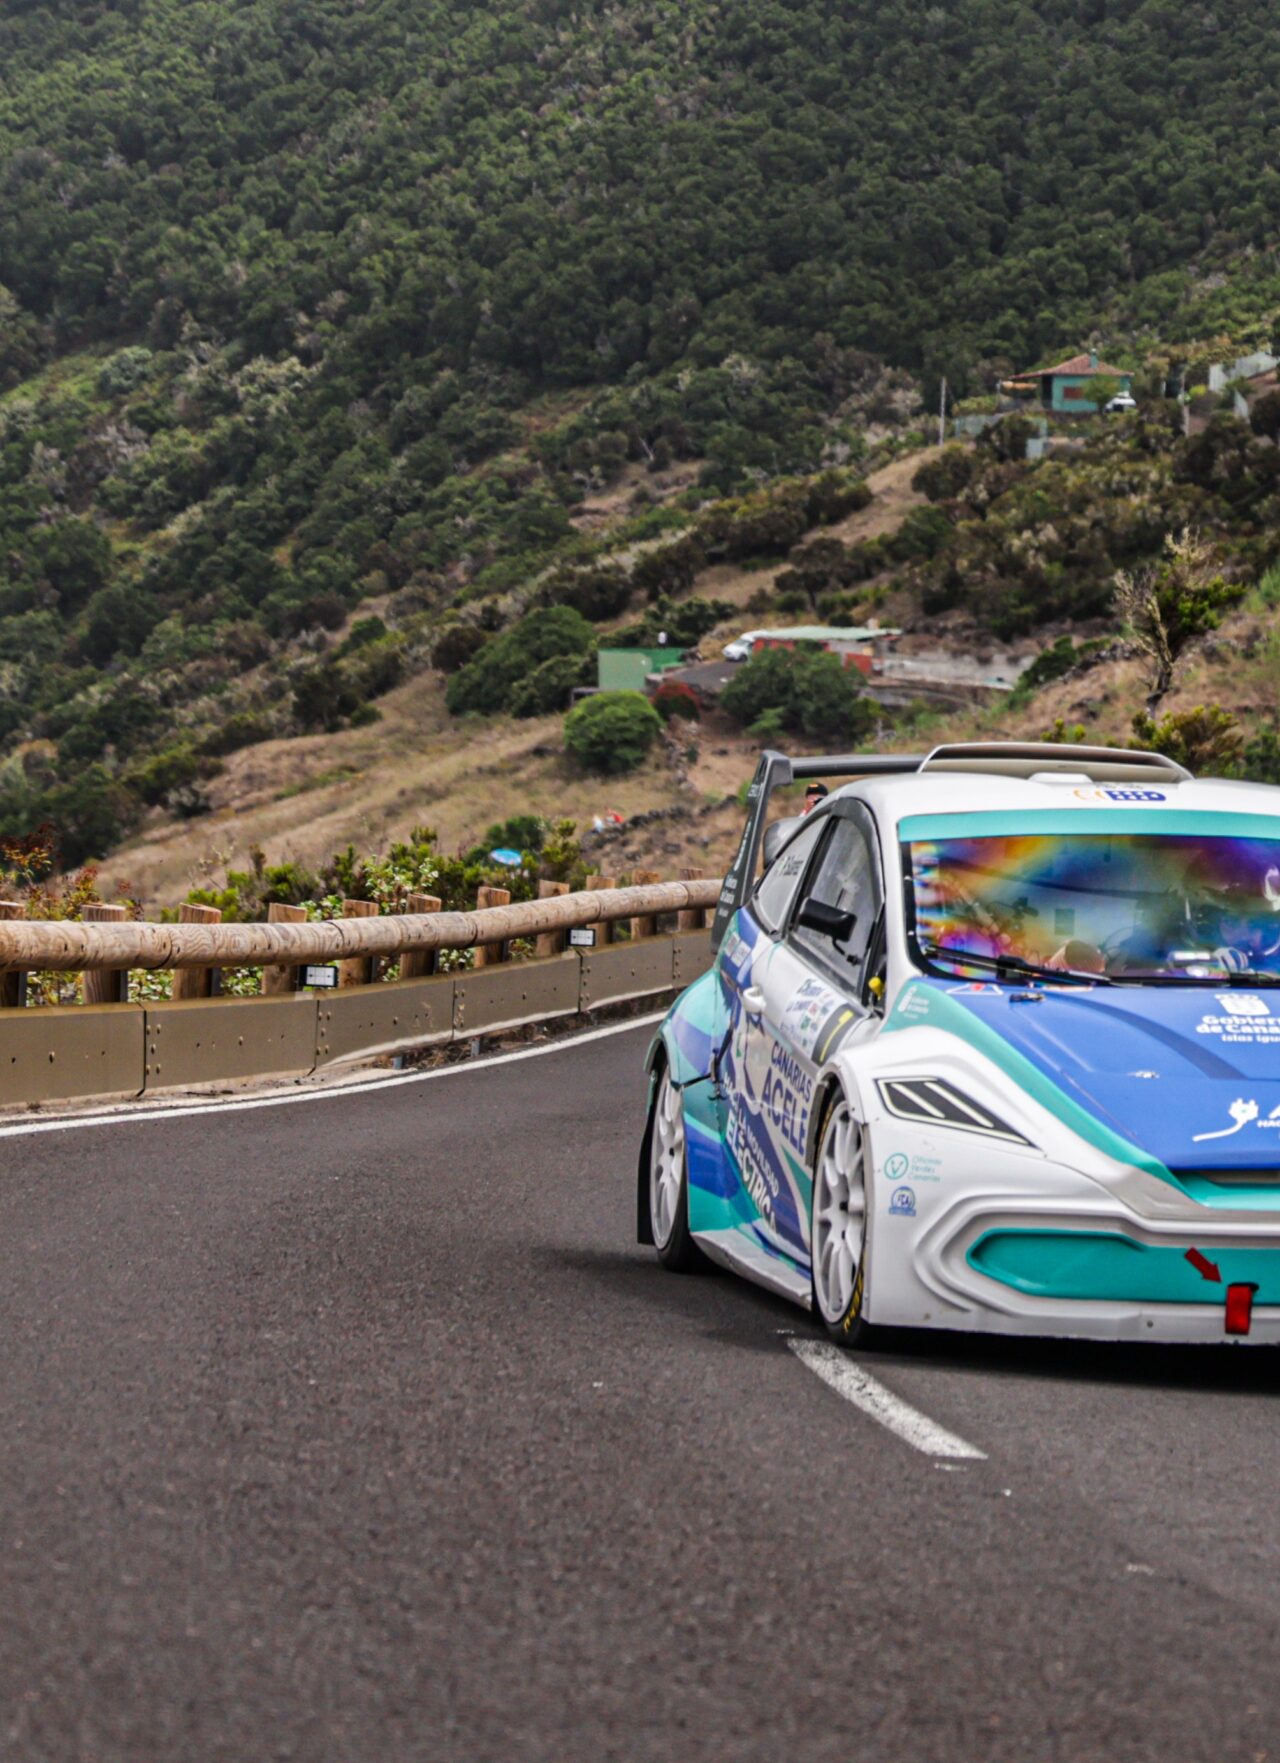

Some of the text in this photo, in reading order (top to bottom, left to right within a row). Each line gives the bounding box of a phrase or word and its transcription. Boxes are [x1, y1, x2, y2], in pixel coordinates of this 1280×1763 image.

[1196, 1023, 1222, 1034] de
[1222, 1034, 1253, 1043] islas
[771, 1040, 812, 1103] CANARIAS
